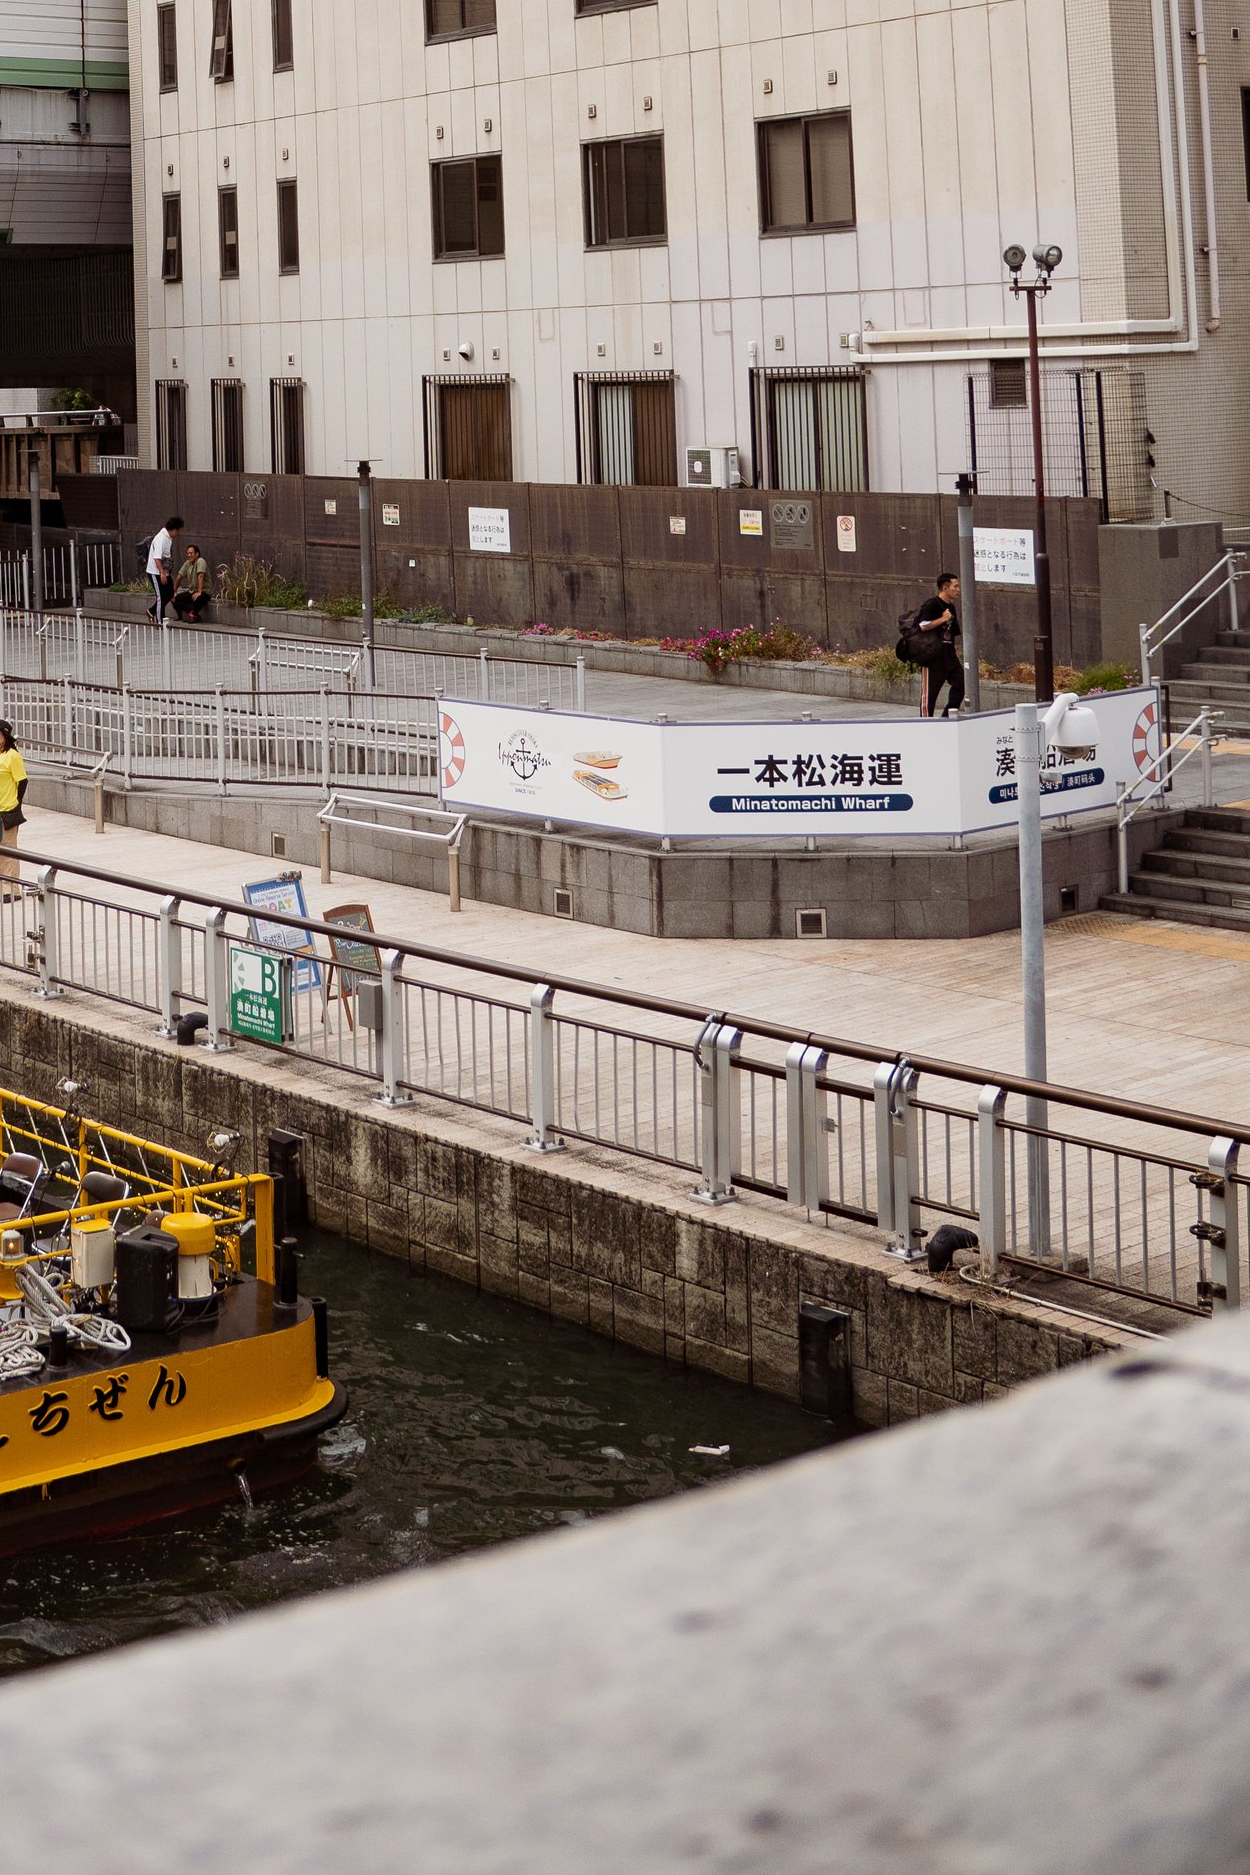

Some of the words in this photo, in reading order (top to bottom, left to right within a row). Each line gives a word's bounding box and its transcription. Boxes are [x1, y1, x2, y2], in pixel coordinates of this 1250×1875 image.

[717, 753, 904, 788] 一本松海運
[731, 798, 836, 811] Minatomachi
[841, 797, 890, 810] Wharf
[262, 958, 277, 997] B
